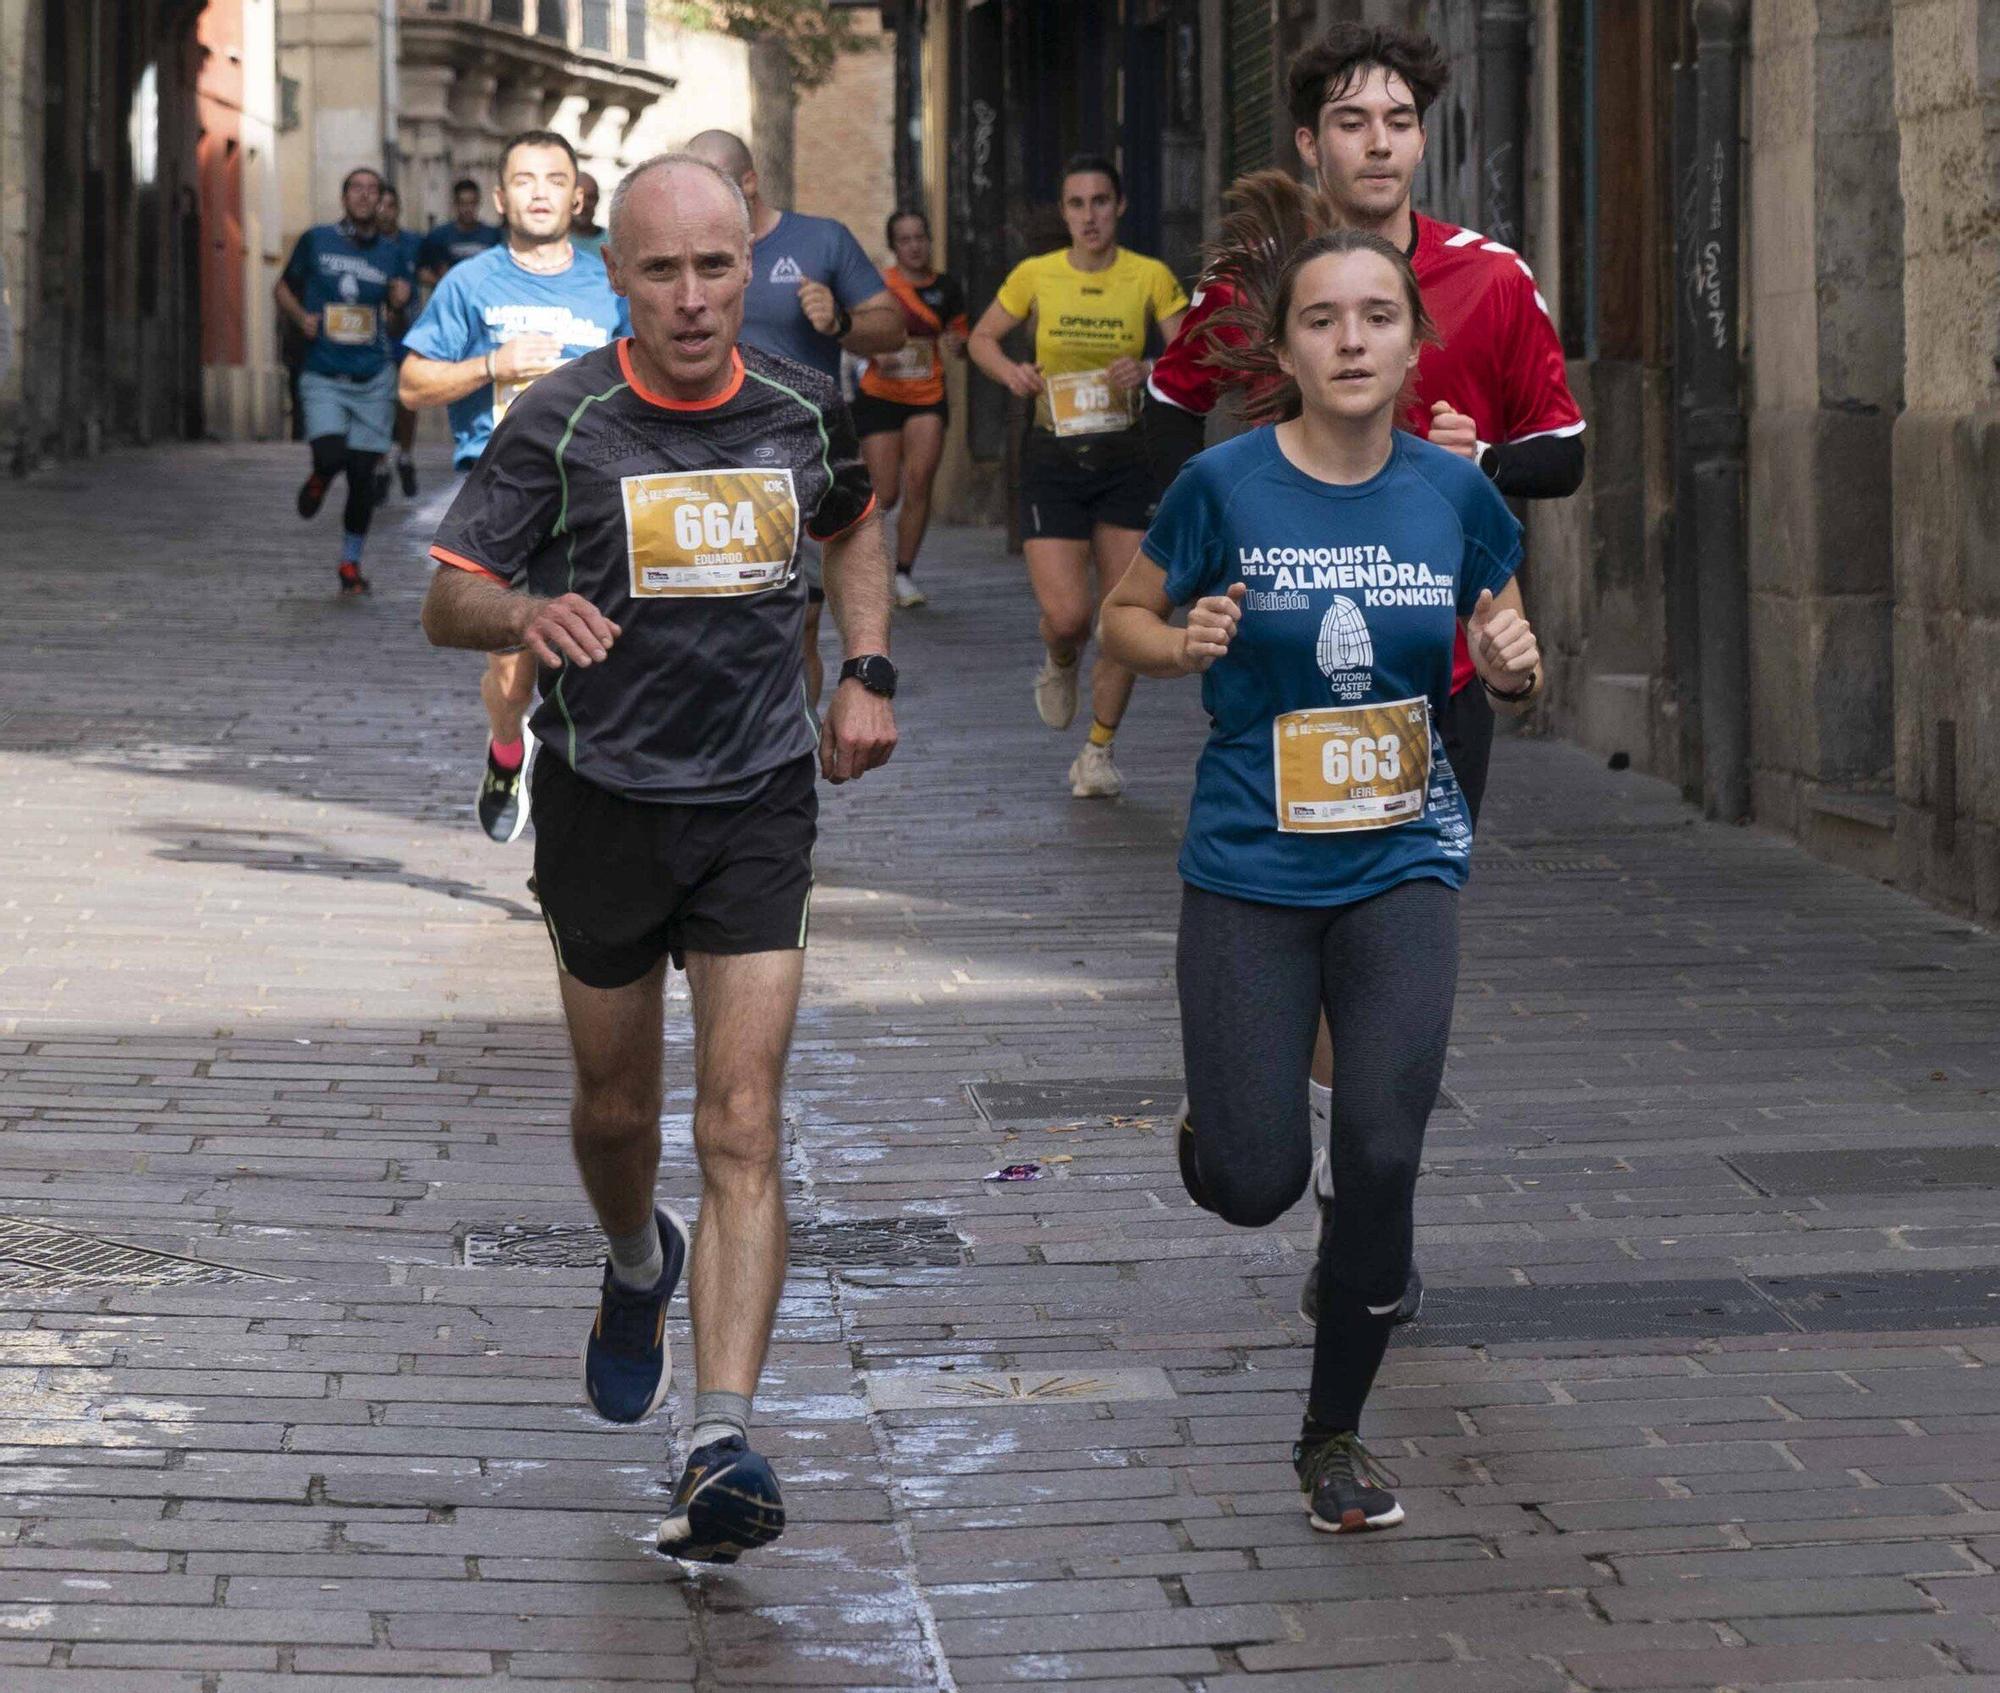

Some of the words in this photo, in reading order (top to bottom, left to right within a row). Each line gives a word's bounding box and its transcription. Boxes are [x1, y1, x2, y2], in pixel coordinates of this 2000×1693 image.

[675, 501, 758, 550] 664
[695, 552, 743, 565] EDUARDO
[1239, 547, 1265, 564] LA
[1267, 545, 1392, 567] CONQUISTA
[1241, 565, 1257, 576] DE
[1259, 564, 1276, 576] LA
[1274, 562, 1435, 590] ALMENDRA
[1257, 590, 1310, 611] Edición
[1364, 588, 1455, 607] KONKISTA
[1331, 672, 1373, 683] VITORIA
[1331, 682, 1372, 692] GASTEIZ
[1340, 691, 1362, 701] 2025
[1322, 734, 1401, 785] 663
[1351, 786, 1378, 799] LEIRE
